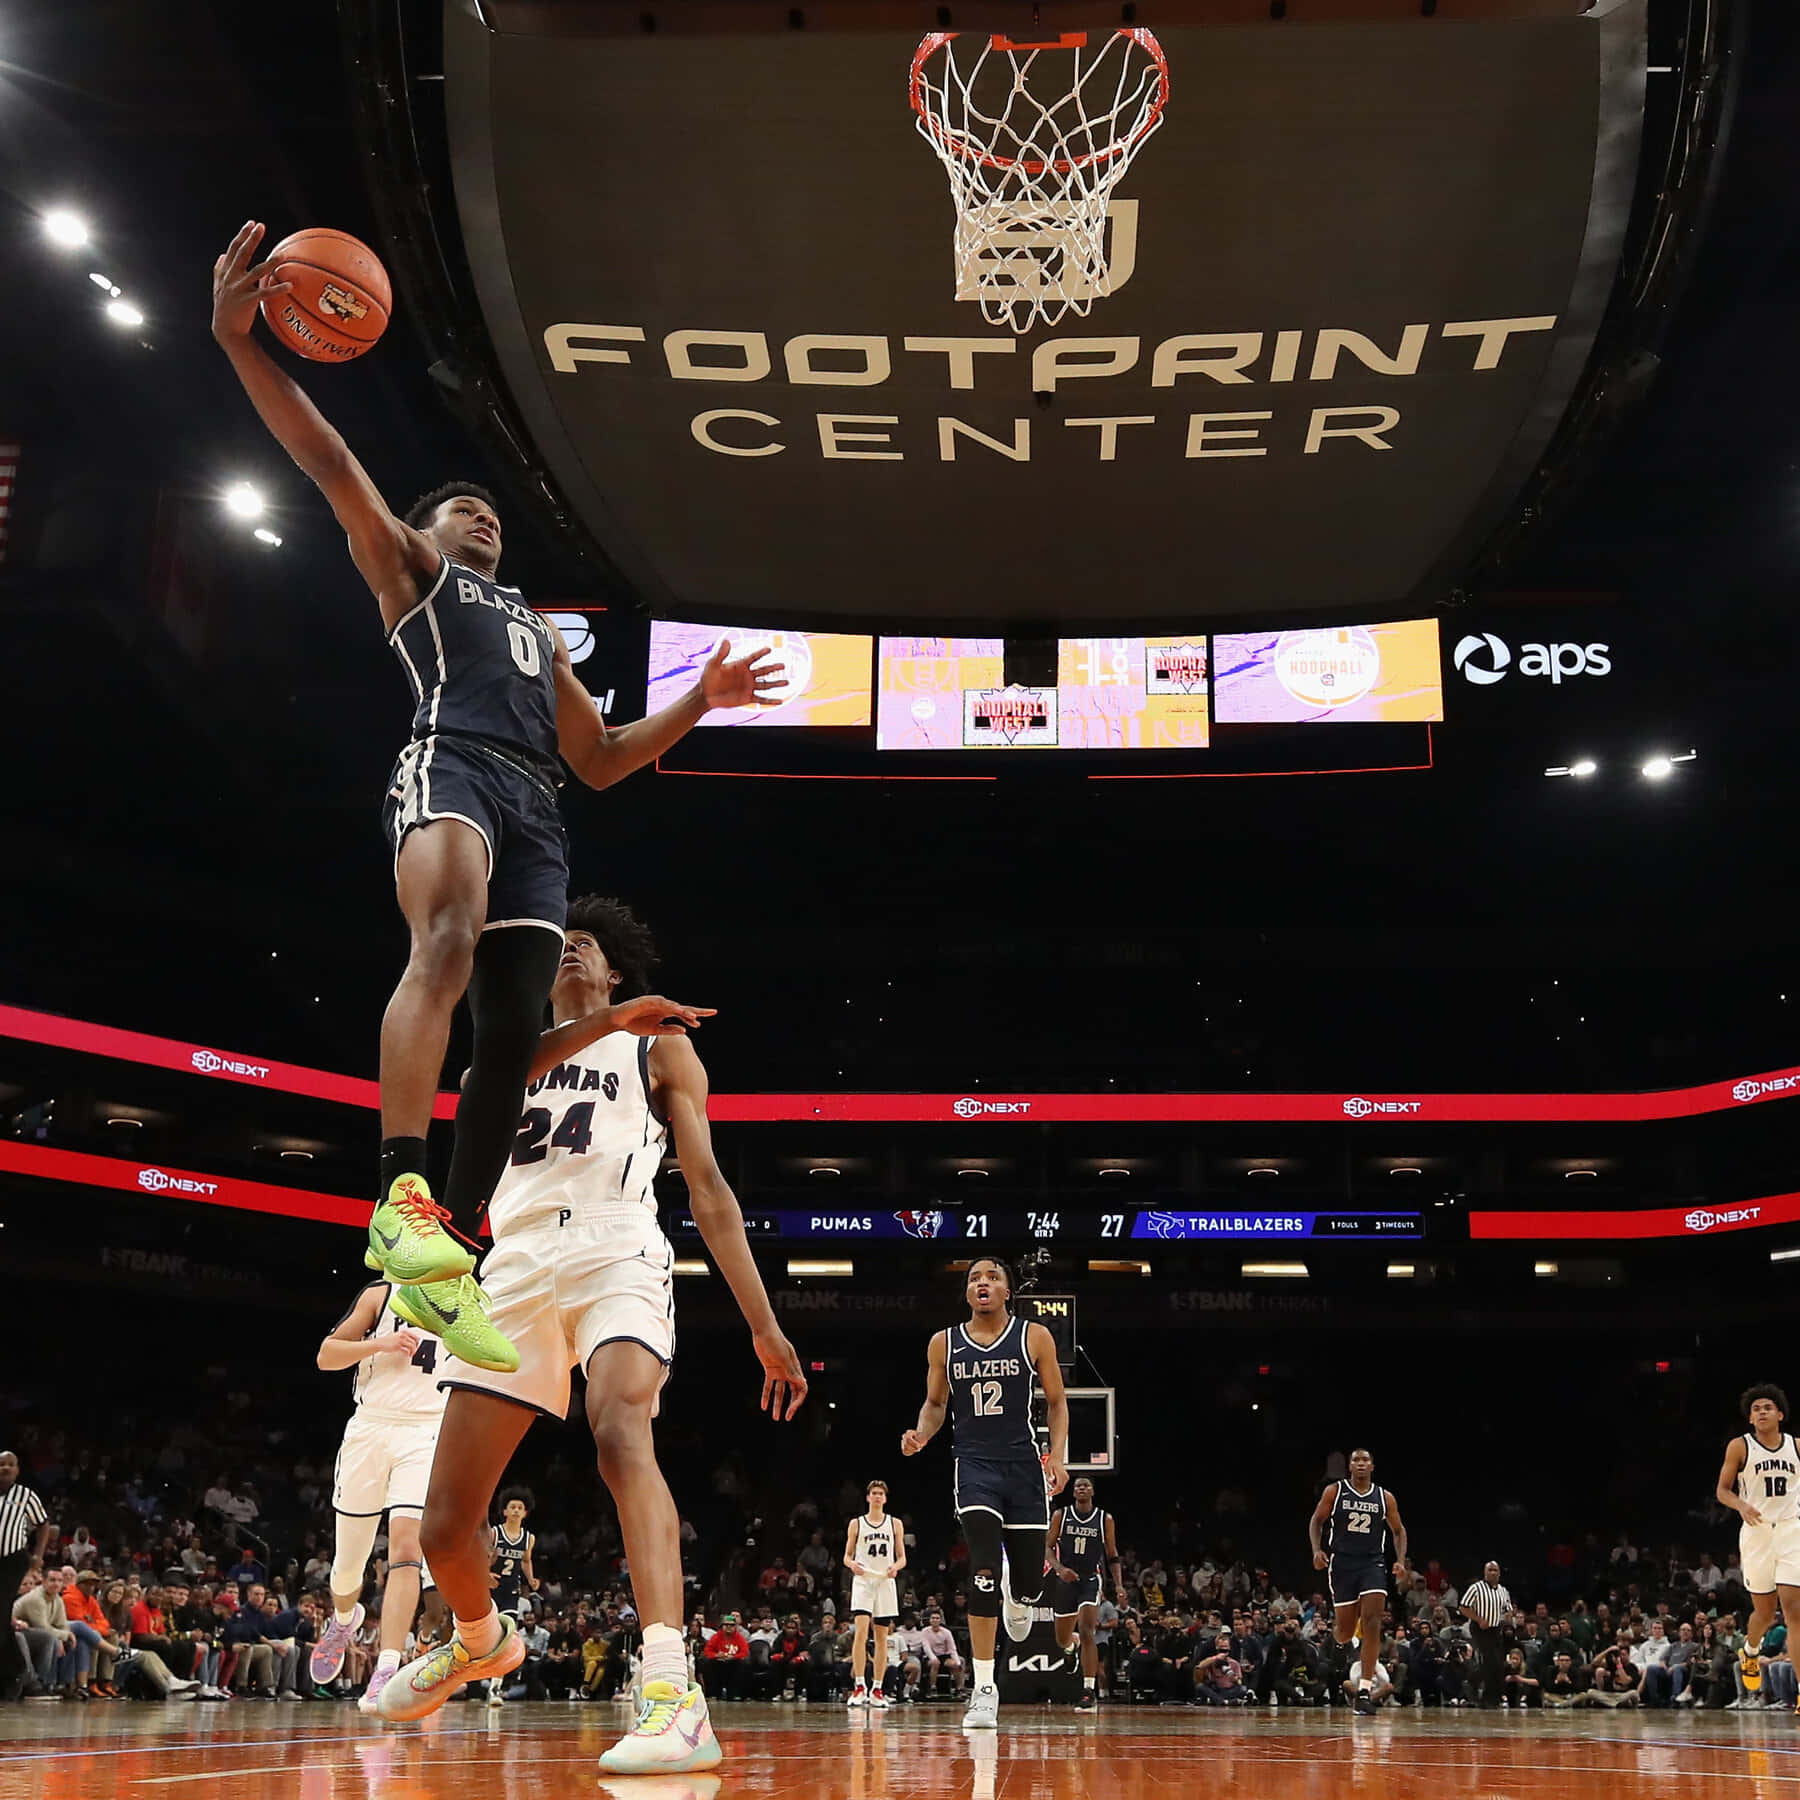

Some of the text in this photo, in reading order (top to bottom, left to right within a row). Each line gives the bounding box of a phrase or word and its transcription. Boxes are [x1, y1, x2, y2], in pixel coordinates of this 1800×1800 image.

[543, 315, 1558, 392] FOOTPRINT
[690, 406, 1401, 461] CENTER
[506, 621, 540, 677] 0
[1519, 642, 1612, 684] aps
[222, 1060, 270, 1078] NEXT
[527, 1063, 620, 1101] UMAS
[983, 1102, 1031, 1113] NEXT
[1373, 1102, 1421, 1113] NEXT
[511, 1101, 596, 1167] 24
[169, 1177, 218, 1195] NEXT
[559, 1209, 571, 1227] P
[811, 1217, 872, 1230] PUMAS
[1027, 1212, 1060, 1230] 7:44
[1189, 1218, 1302, 1231] TRAILBLAZERS
[1715, 1207, 1761, 1224] NEXT
[966, 1215, 987, 1238] 21
[1101, 1215, 1124, 1237] 27
[1331, 1221, 1359, 1230] 1 FOULS
[1382, 1221, 1415, 1229] TIMEOUTS
[1033, 1301, 1068, 1316] 7:44
[953, 1358, 1020, 1380] BLAZERS
[970, 1380, 1004, 1417] 12
[1754, 1459, 1796, 1475] PUMAS
[1342, 1500, 1379, 1513] BLAZERS
[1066, 1525, 1098, 1537] BLAZERS
[1347, 1512, 1371, 1533] 22
[864, 1532, 890, 1544] PUMAS
[1074, 1536, 1087, 1554] 11
[868, 1543, 888, 1557] 44
[501, 1560, 514, 1576] 2
